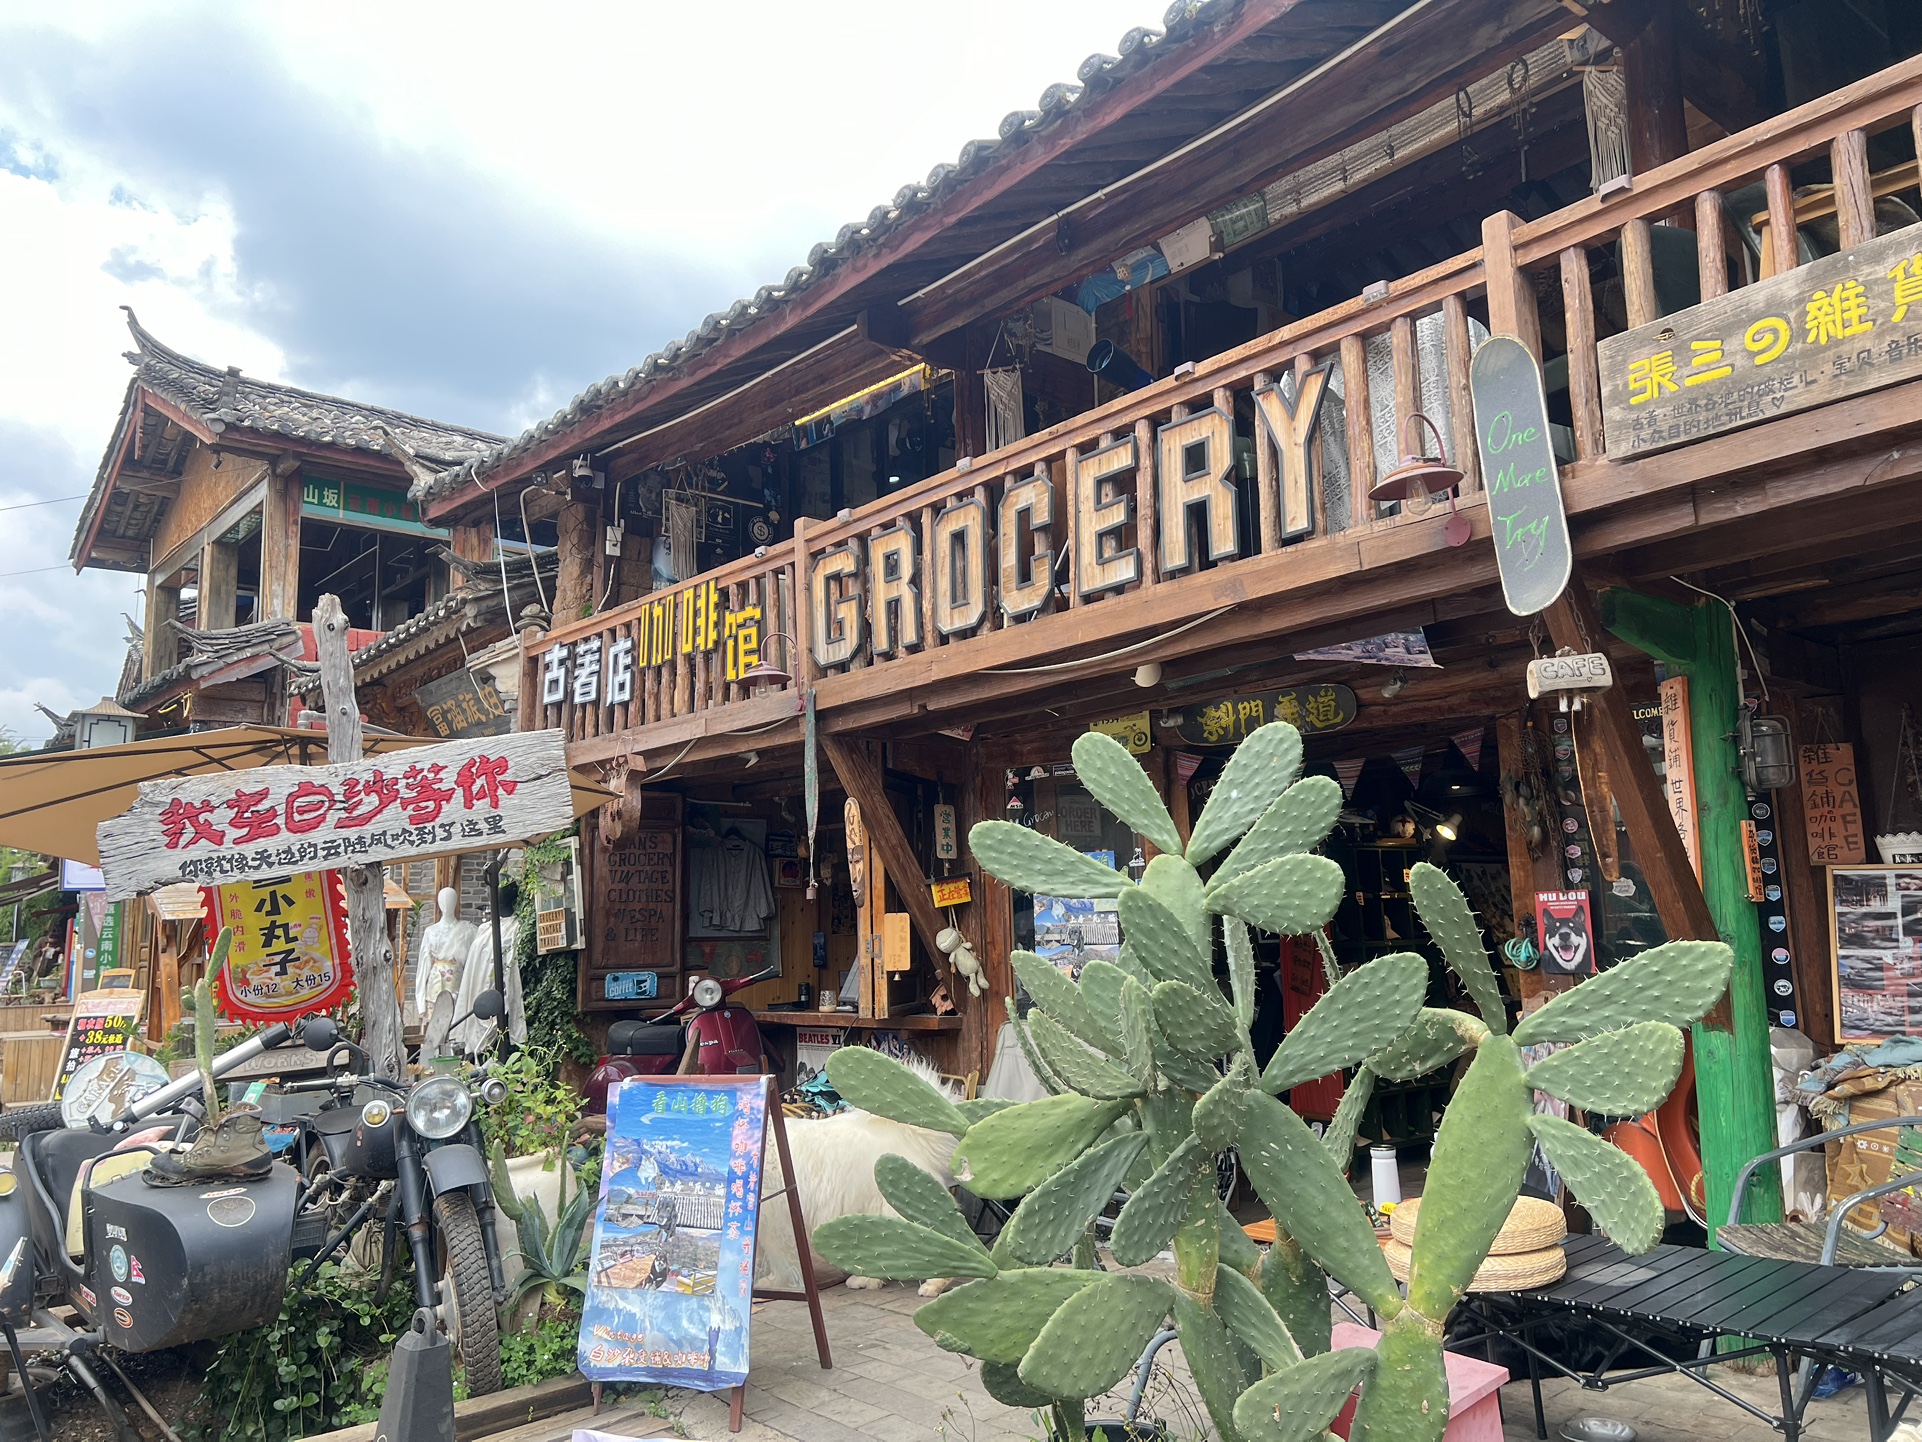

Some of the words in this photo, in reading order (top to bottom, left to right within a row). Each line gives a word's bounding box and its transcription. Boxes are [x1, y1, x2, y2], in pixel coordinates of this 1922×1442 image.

[1487, 411, 1541, 454] One
[1491, 463, 1550, 495] More
[303, 484, 339, 507] 山坂
[811, 361, 1335, 668] GROCERY
[1497, 505, 1549, 571] Try
[1540, 656, 1606, 680] CAFE
[159, 754, 519, 850] 我在白沙等你
[1061, 805, 1098, 820] ORDER
[1065, 820, 1095, 833] HERE
[177, 813, 507, 879] 你就像天边的云随风吹到了这里
[608, 852, 674, 867] GROCERY
[609, 870, 670, 885] VINTAGE
[607, 888, 674, 903] CLOTHES
[1539, 892, 1557, 901] HU
[251, 875, 301, 977] 小丸子
[617, 908, 665, 925] VESPA
[605, 927, 617, 941] &
[624, 927, 659, 942] LIFE
[240, 982, 278, 998] 小份12
[291, 971, 331, 990] 大份15
[609, 983, 633, 997] COFFEE
[798, 1033, 830, 1044] BEATLES
[831, 1034, 842, 1045] VI
[244, 1050, 317, 1072] WORKS
[592, 1324, 646, 1345] Vintage
